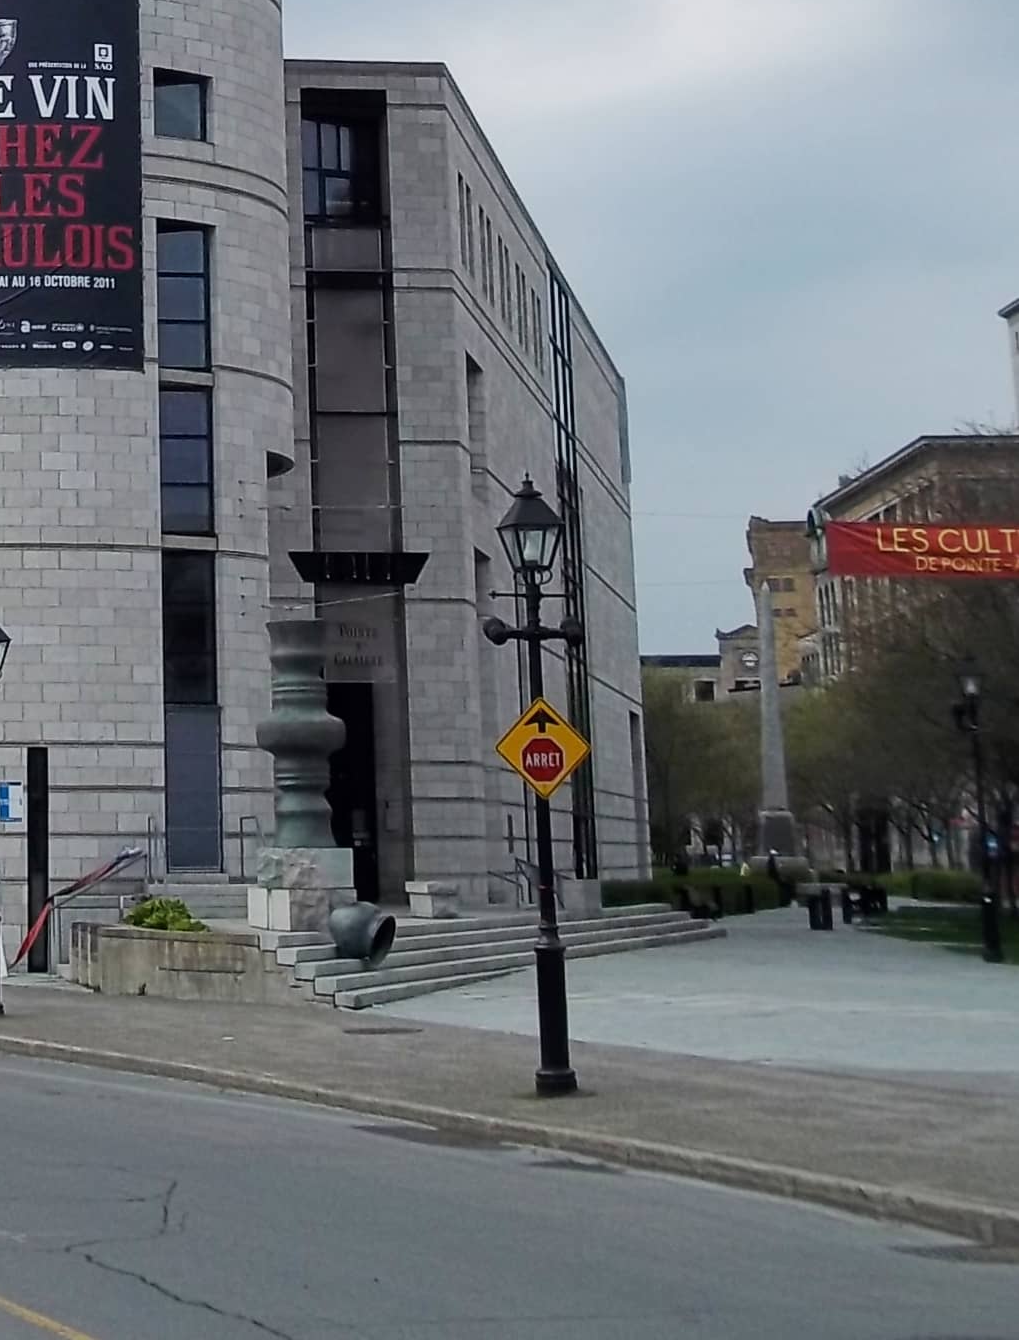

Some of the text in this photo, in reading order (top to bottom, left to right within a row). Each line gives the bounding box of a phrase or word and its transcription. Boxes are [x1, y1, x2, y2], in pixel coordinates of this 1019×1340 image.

[94, 62, 113, 71] SAQ
[28, 75, 115, 120] VIN
[12, 275, 25, 288] AU
[44, 275, 90, 288] OCTOBRE
[93, 276, 116, 289] 2011
[876, 528, 1019, 553] LES CULT
[916, 556, 938, 571] DE
